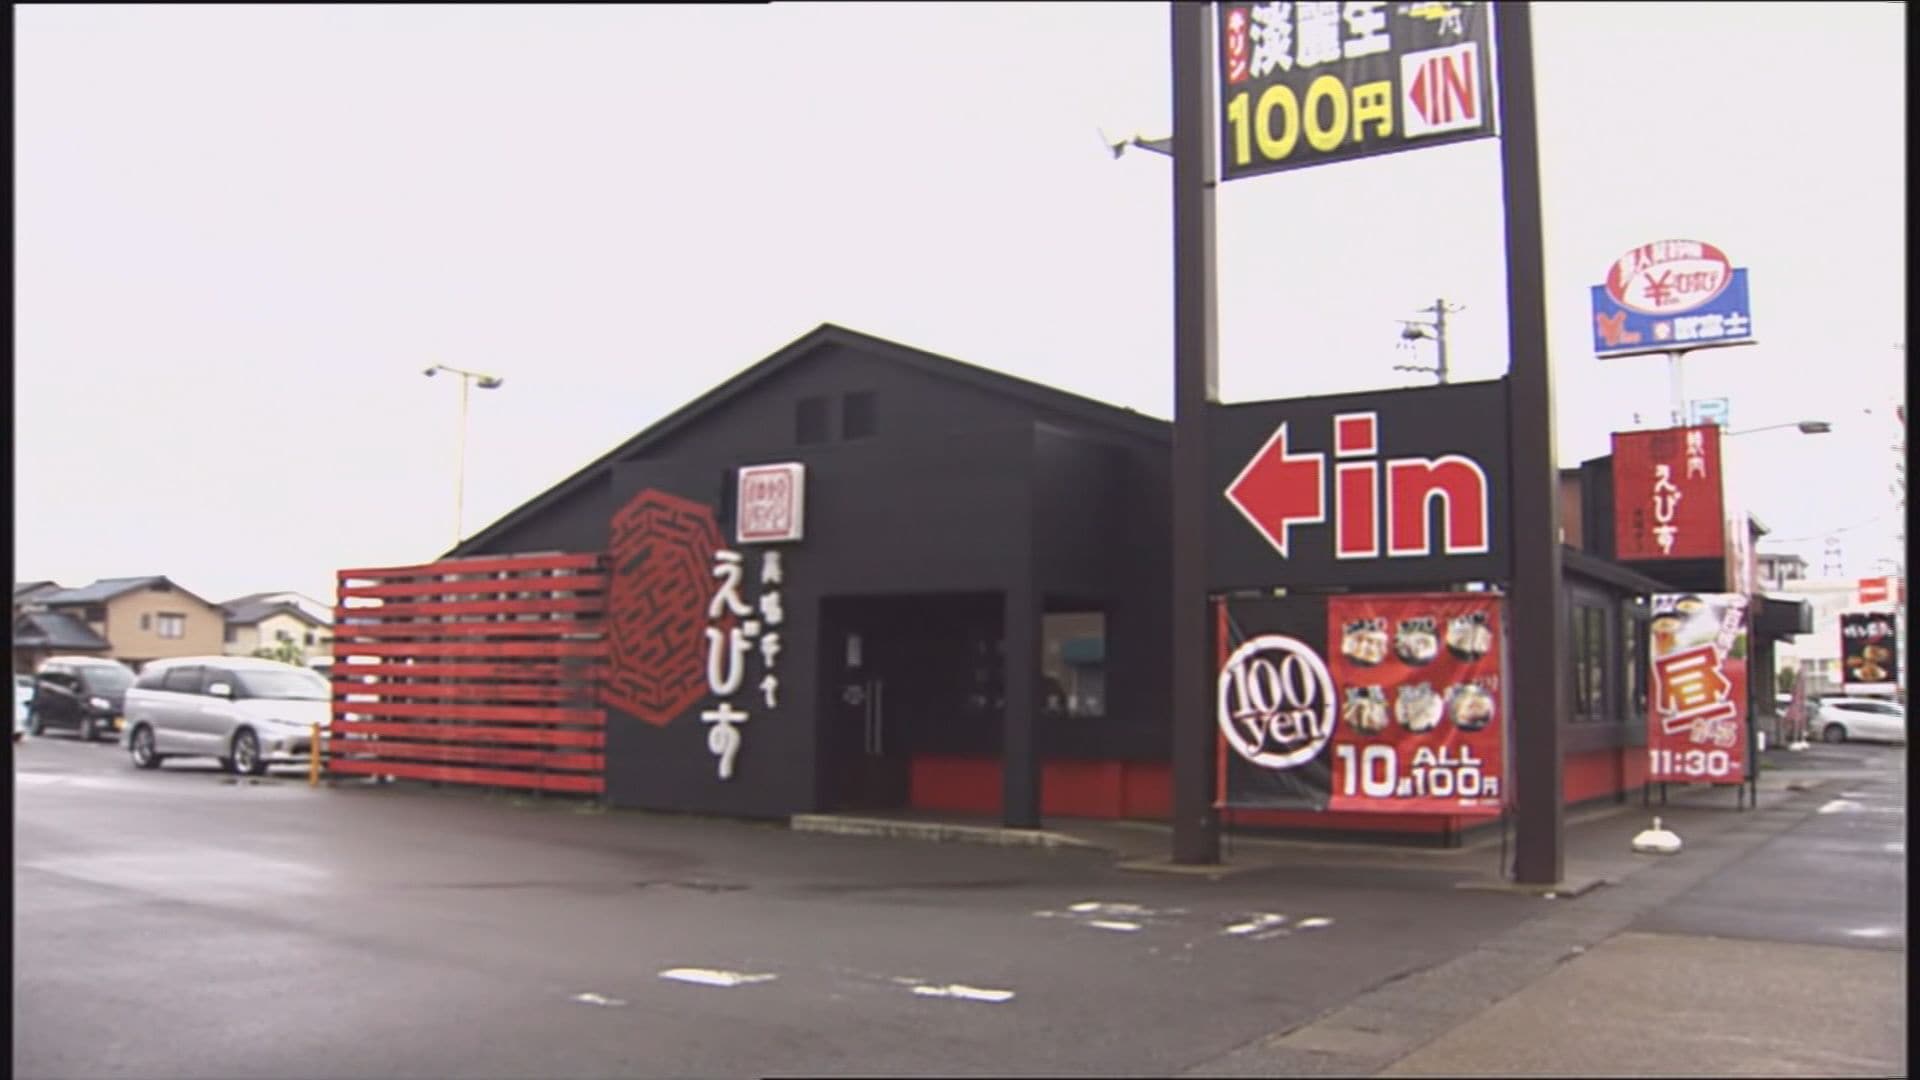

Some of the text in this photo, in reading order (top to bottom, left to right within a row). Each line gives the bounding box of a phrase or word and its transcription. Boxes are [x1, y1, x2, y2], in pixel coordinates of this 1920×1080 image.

[1228, 75, 1394, 165] 100円
[1430, 50, 1476, 126] IN
[1334, 412, 1489, 559] in
[1652, 464, 1682, 555] えびす
[701, 550, 760, 779] えびす
[1230, 653, 1316, 717] 100
[1242, 706, 1326, 755] yen
[1412, 746, 1481, 766] ALL
